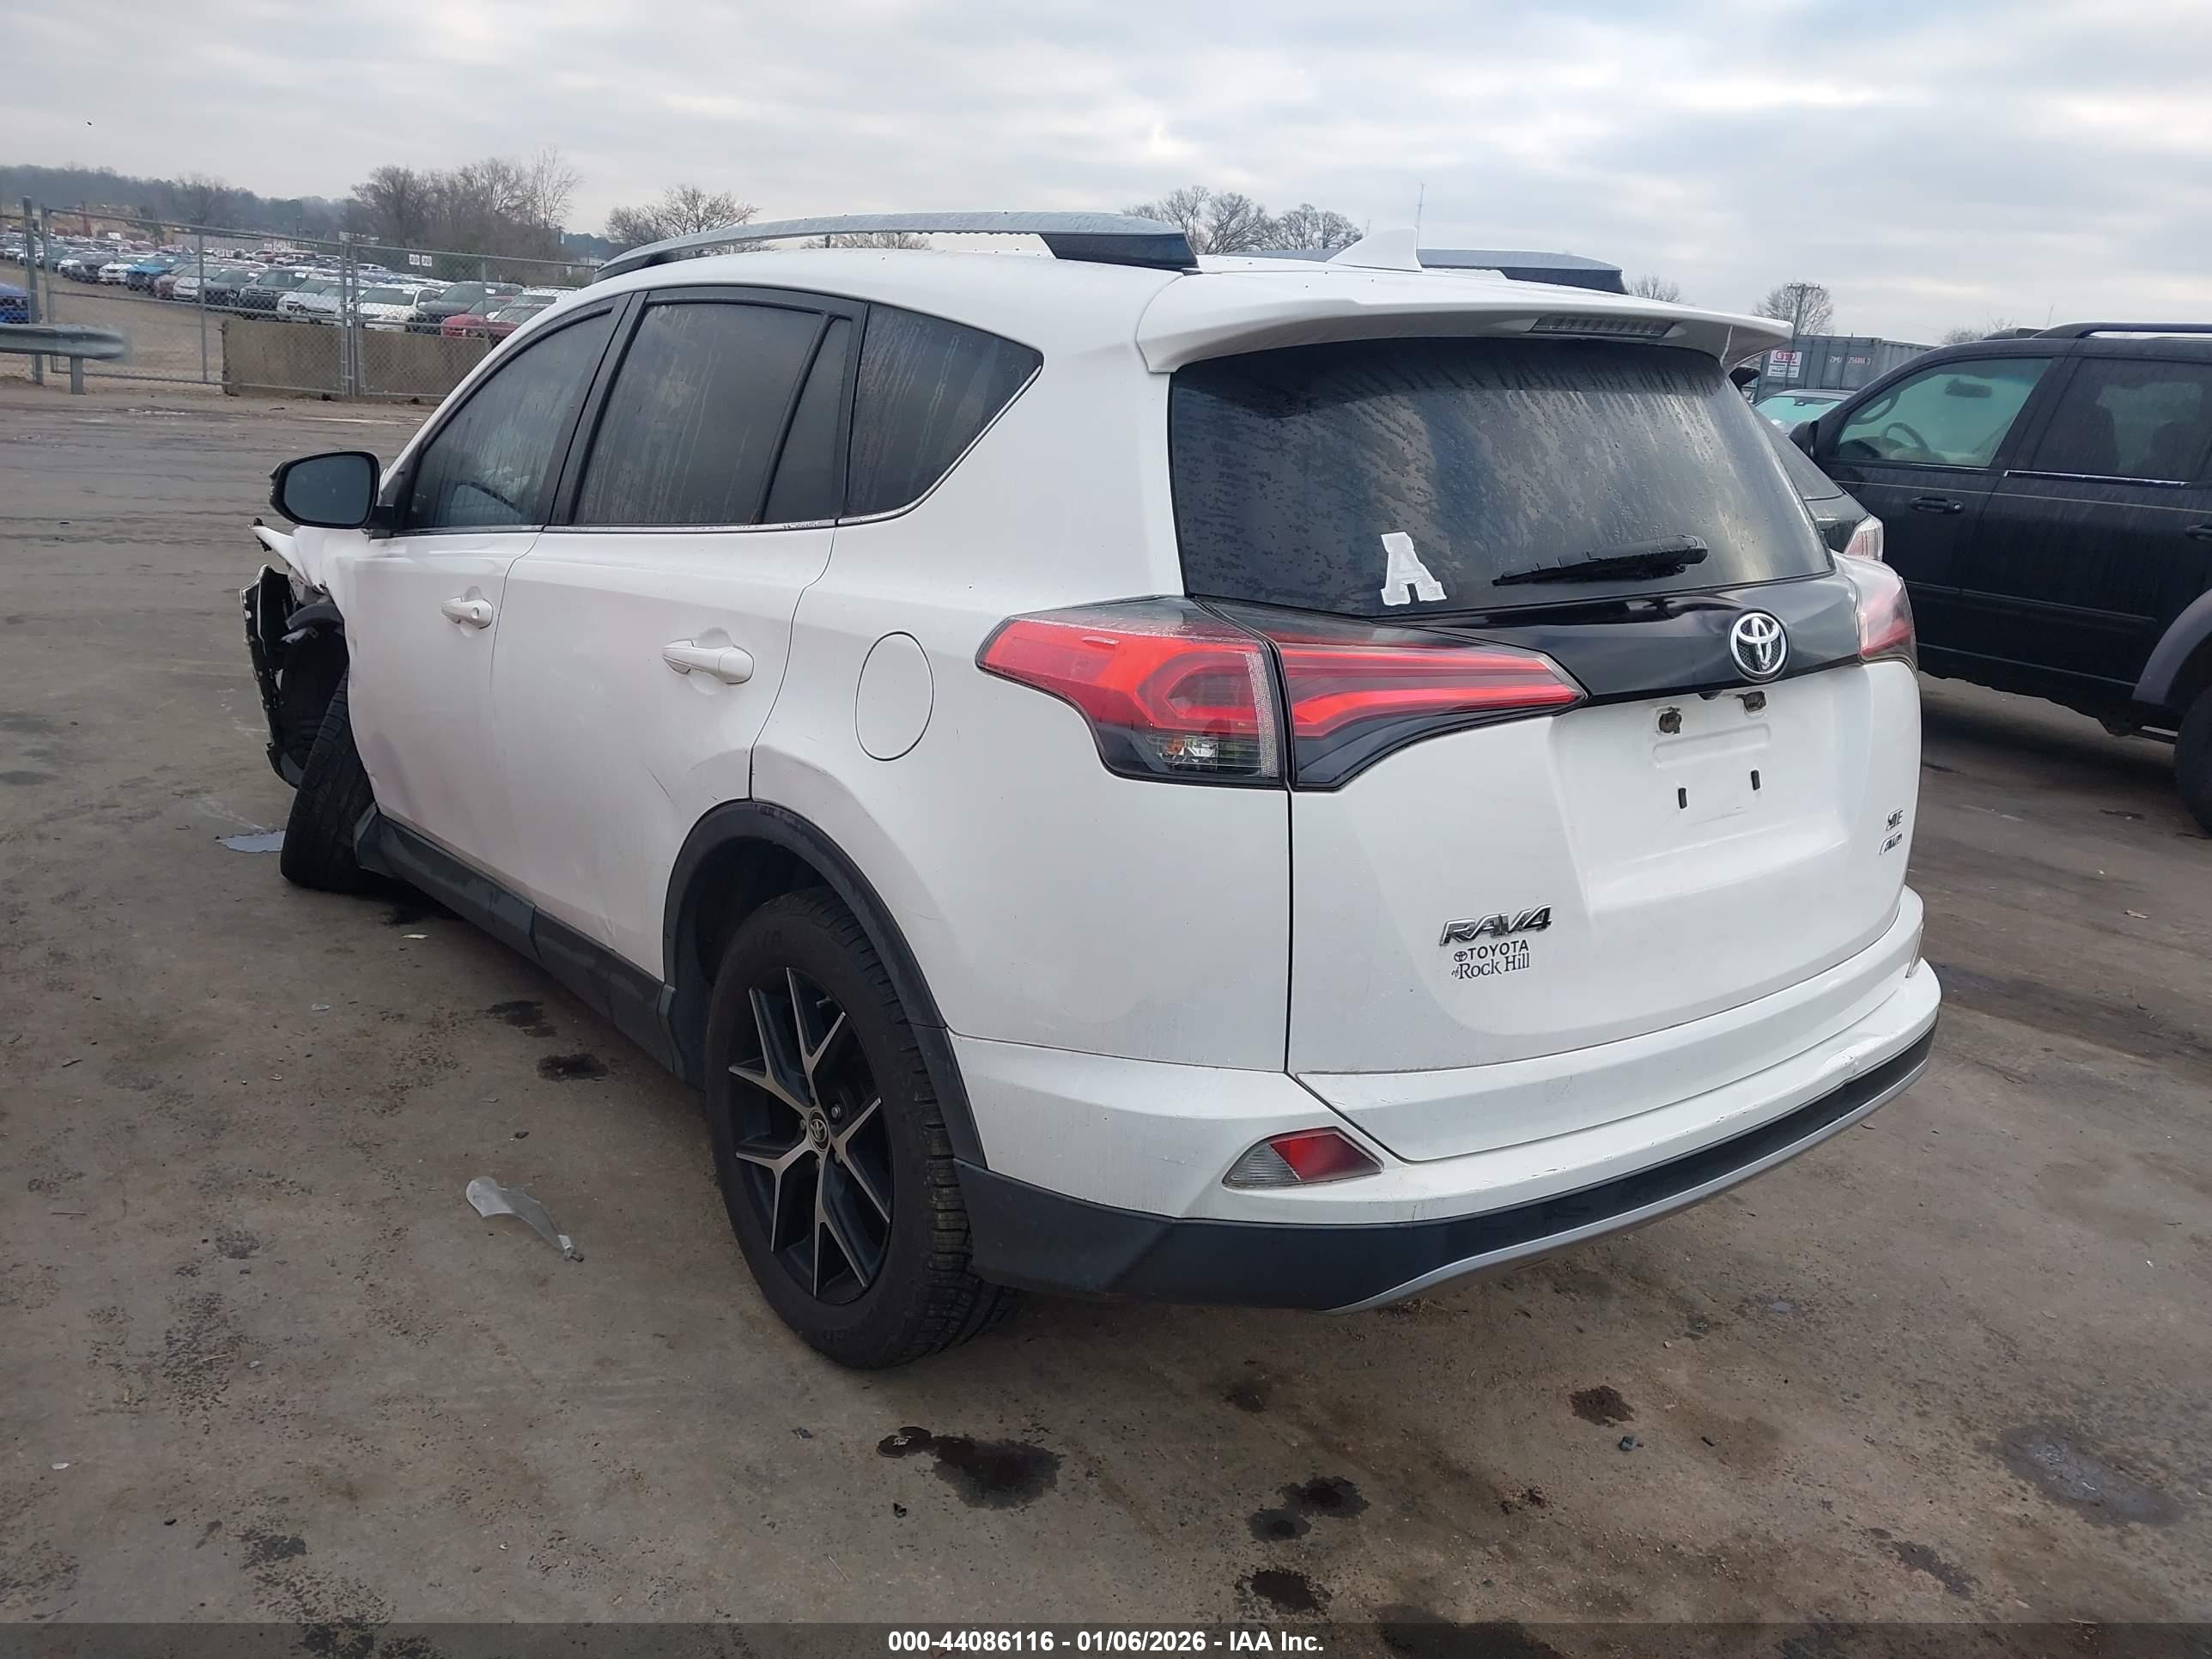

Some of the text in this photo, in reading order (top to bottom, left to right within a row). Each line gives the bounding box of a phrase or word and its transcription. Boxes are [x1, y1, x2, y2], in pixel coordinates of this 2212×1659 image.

[1381, 532, 1448, 606] A
[1439, 903, 1553, 946] RAV4
[1459, 958, 1503, 980] Rock
[1504, 952, 1530, 972] Hill
[1467, 939, 1529, 960] TOYOTA
